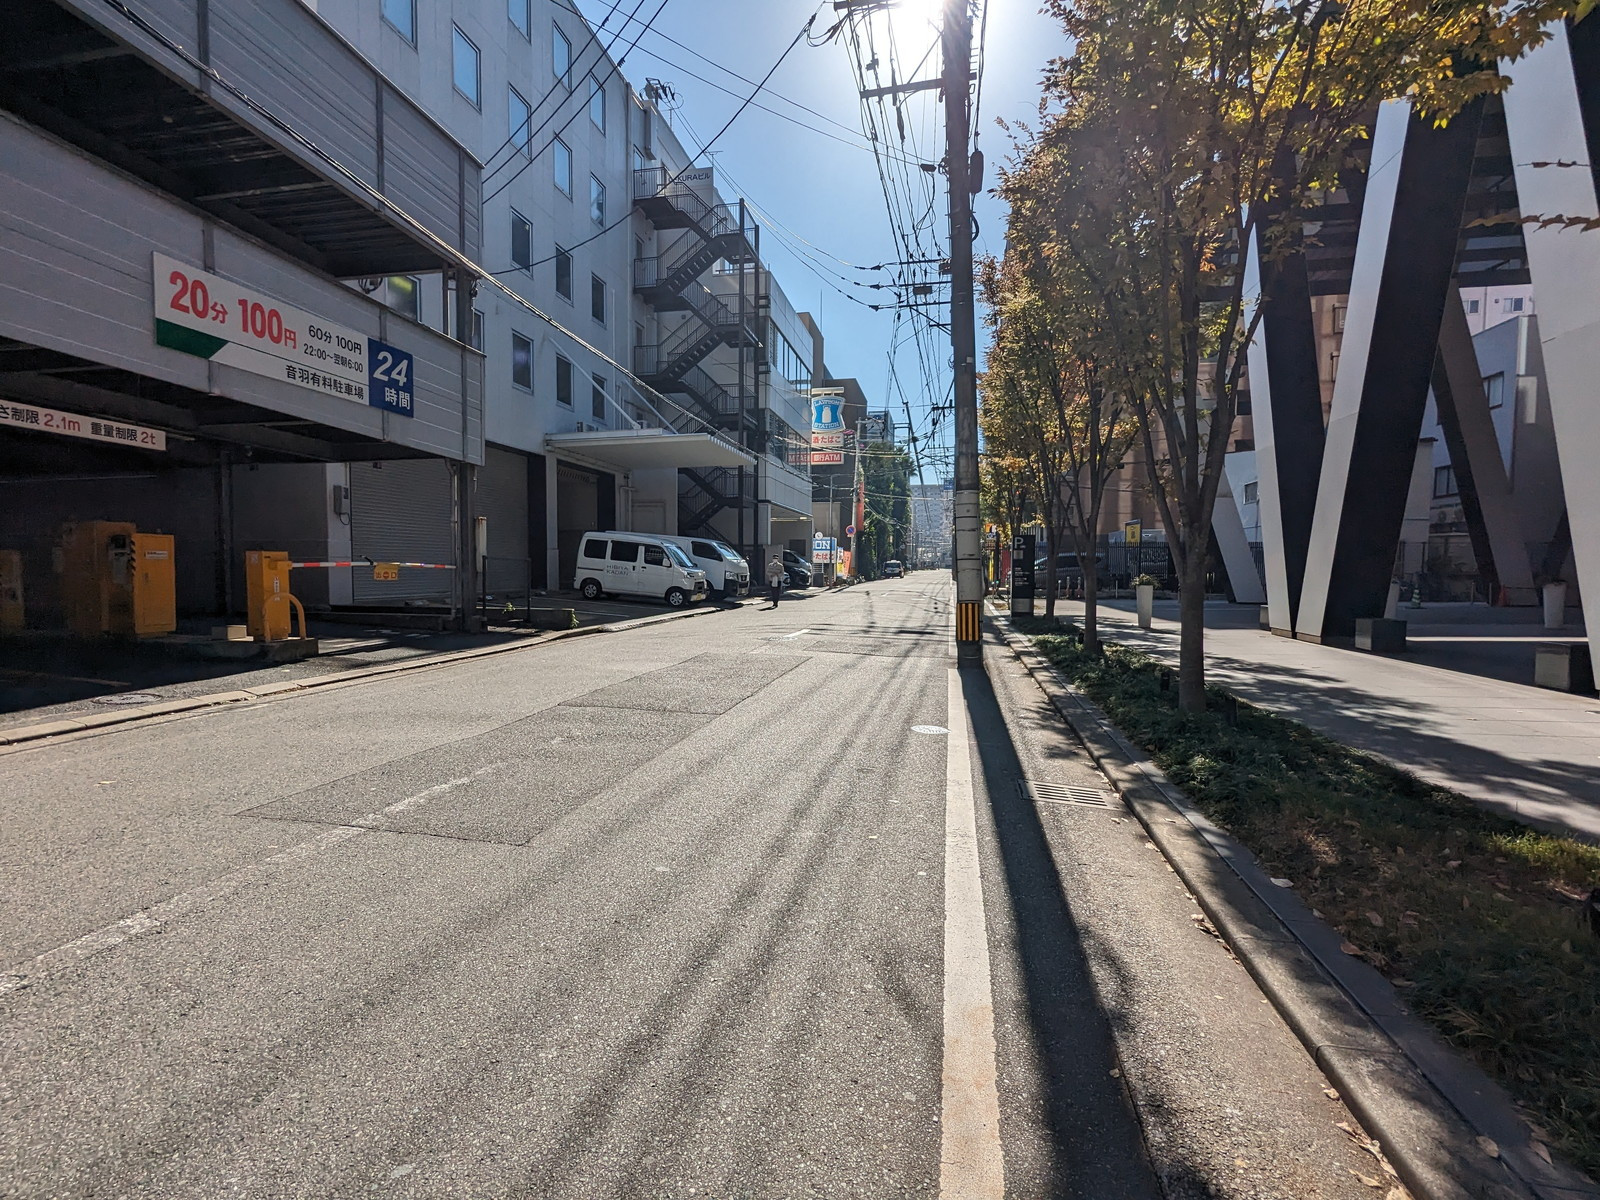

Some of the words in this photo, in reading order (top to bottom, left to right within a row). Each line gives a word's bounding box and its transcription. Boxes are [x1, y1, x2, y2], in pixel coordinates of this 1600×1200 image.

[668, 172, 711, 183] KURAビル
[169, 270, 229, 324] 20分
[238, 298, 297, 349] 100円
[308, 324, 332, 343] 60分
[335, 335, 362, 355] 100円
[285, 364, 364, 400] 音羽有料駐車場
[373, 351, 409, 387] 24
[384, 387, 411, 410] 時間
[43, 413, 81, 432] 2.1m
[90, 421, 138, 442] 重量制限
[140, 431, 156, 445] 2t
[813, 453, 841, 462] 銀行ATM
